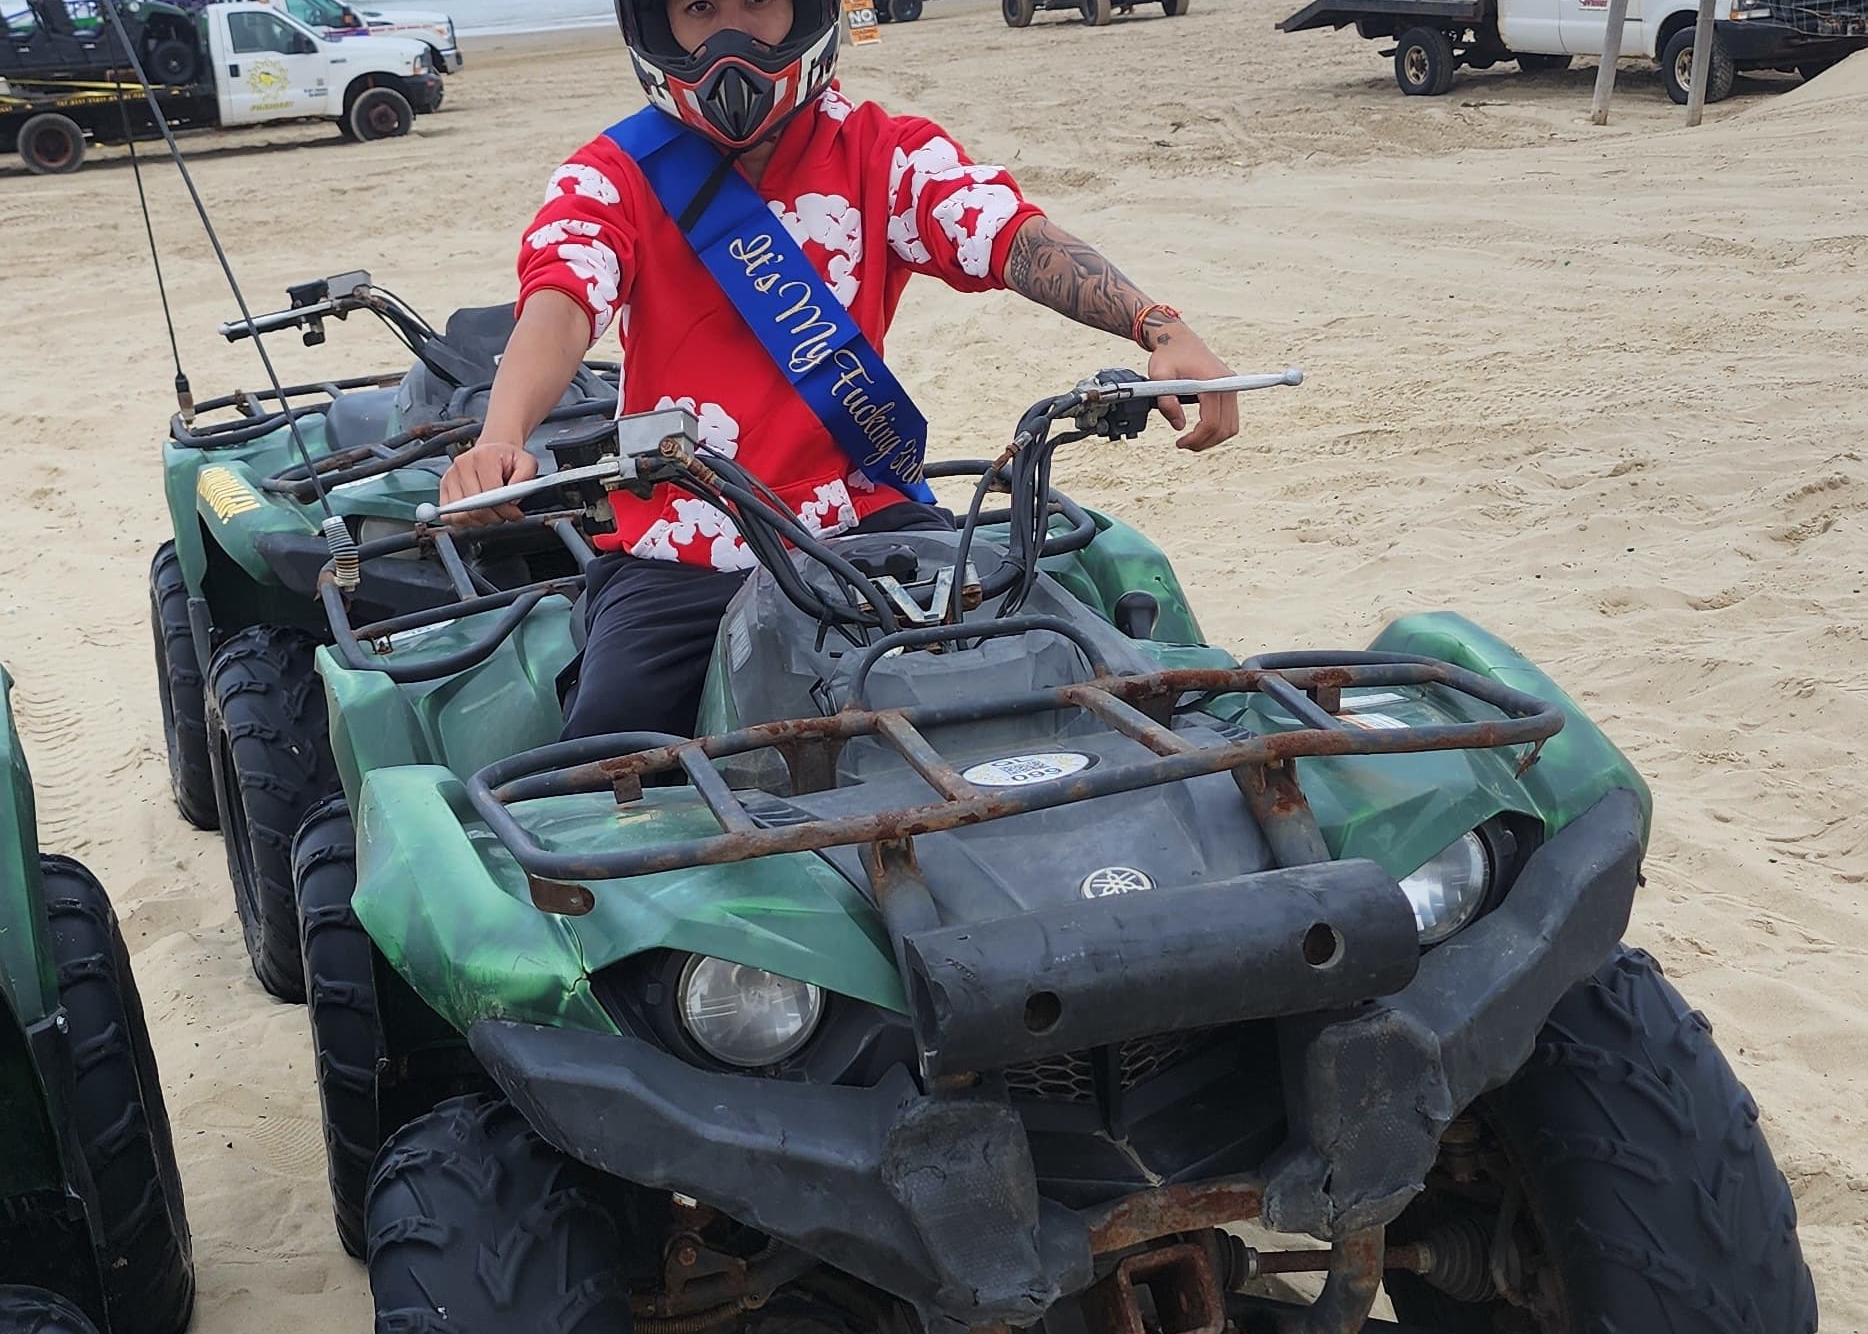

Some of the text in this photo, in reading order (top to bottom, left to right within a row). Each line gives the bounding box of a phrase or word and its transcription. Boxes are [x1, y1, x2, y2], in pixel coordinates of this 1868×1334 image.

[848, 9, 872, 23] NO
[729, 234, 784, 294] It's
[775, 281, 838, 373] My
[830, 349, 901, 466] Fucking
